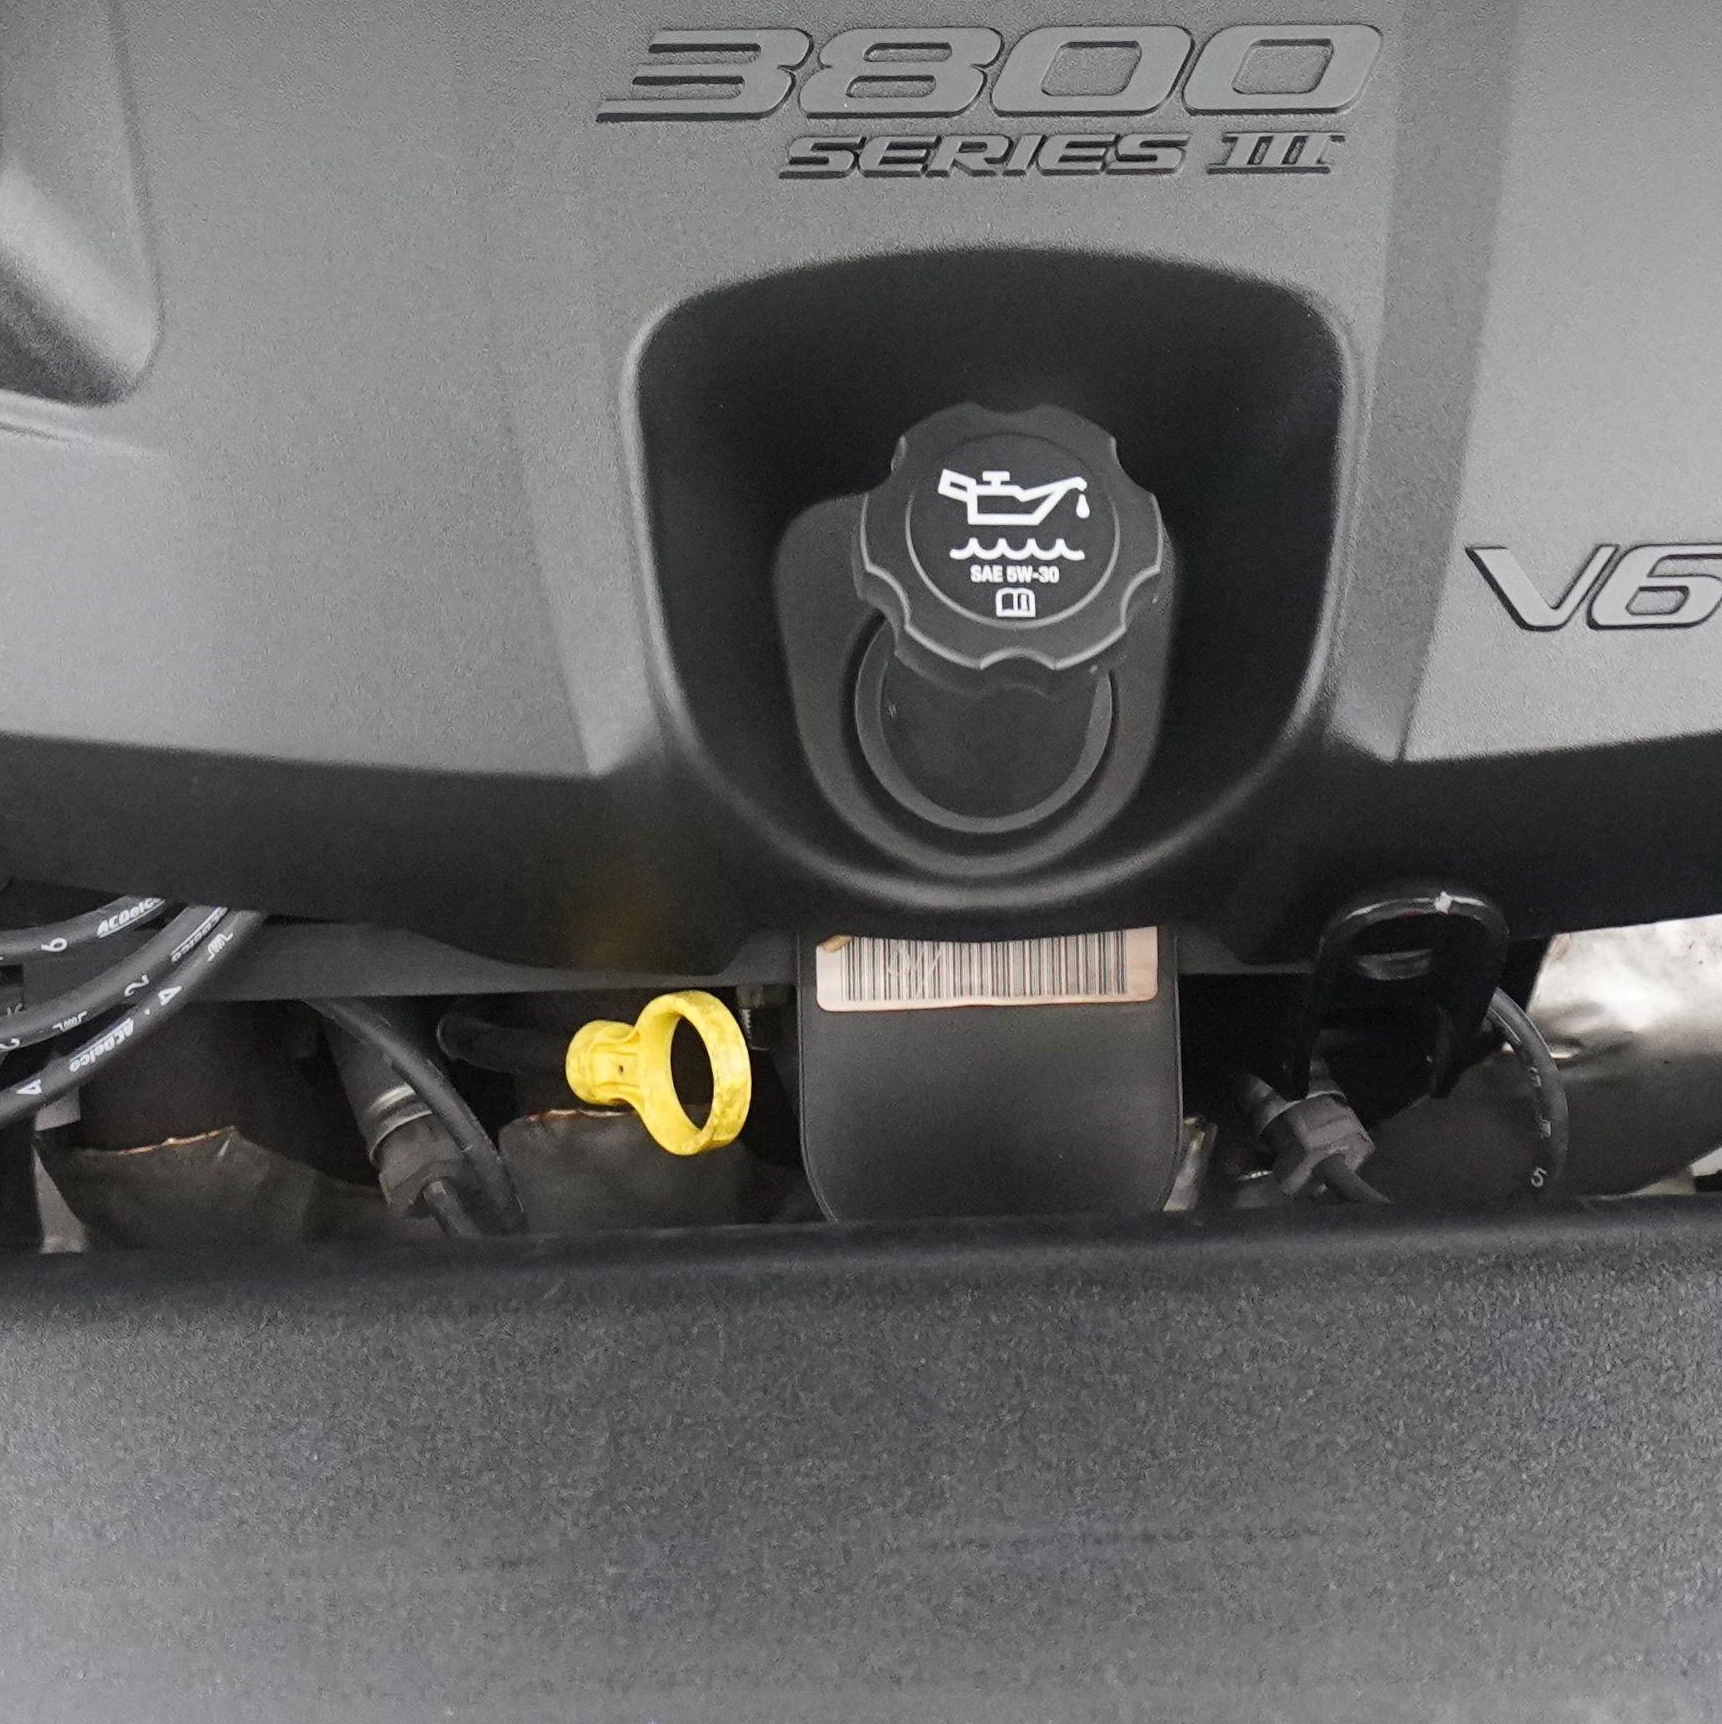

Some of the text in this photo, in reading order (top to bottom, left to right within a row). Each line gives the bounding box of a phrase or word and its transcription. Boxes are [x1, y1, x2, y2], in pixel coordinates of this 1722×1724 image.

[595, 24, 1384, 123] 3800
[778, 131, 1346, 180] SERIES III
[970, 565, 1060, 583] SAE 5W-30
[123, 974, 150, 997] 2
[68, 985, 183, 1072] ACDelco 4
[15, 1078, 43, 1095] 4
